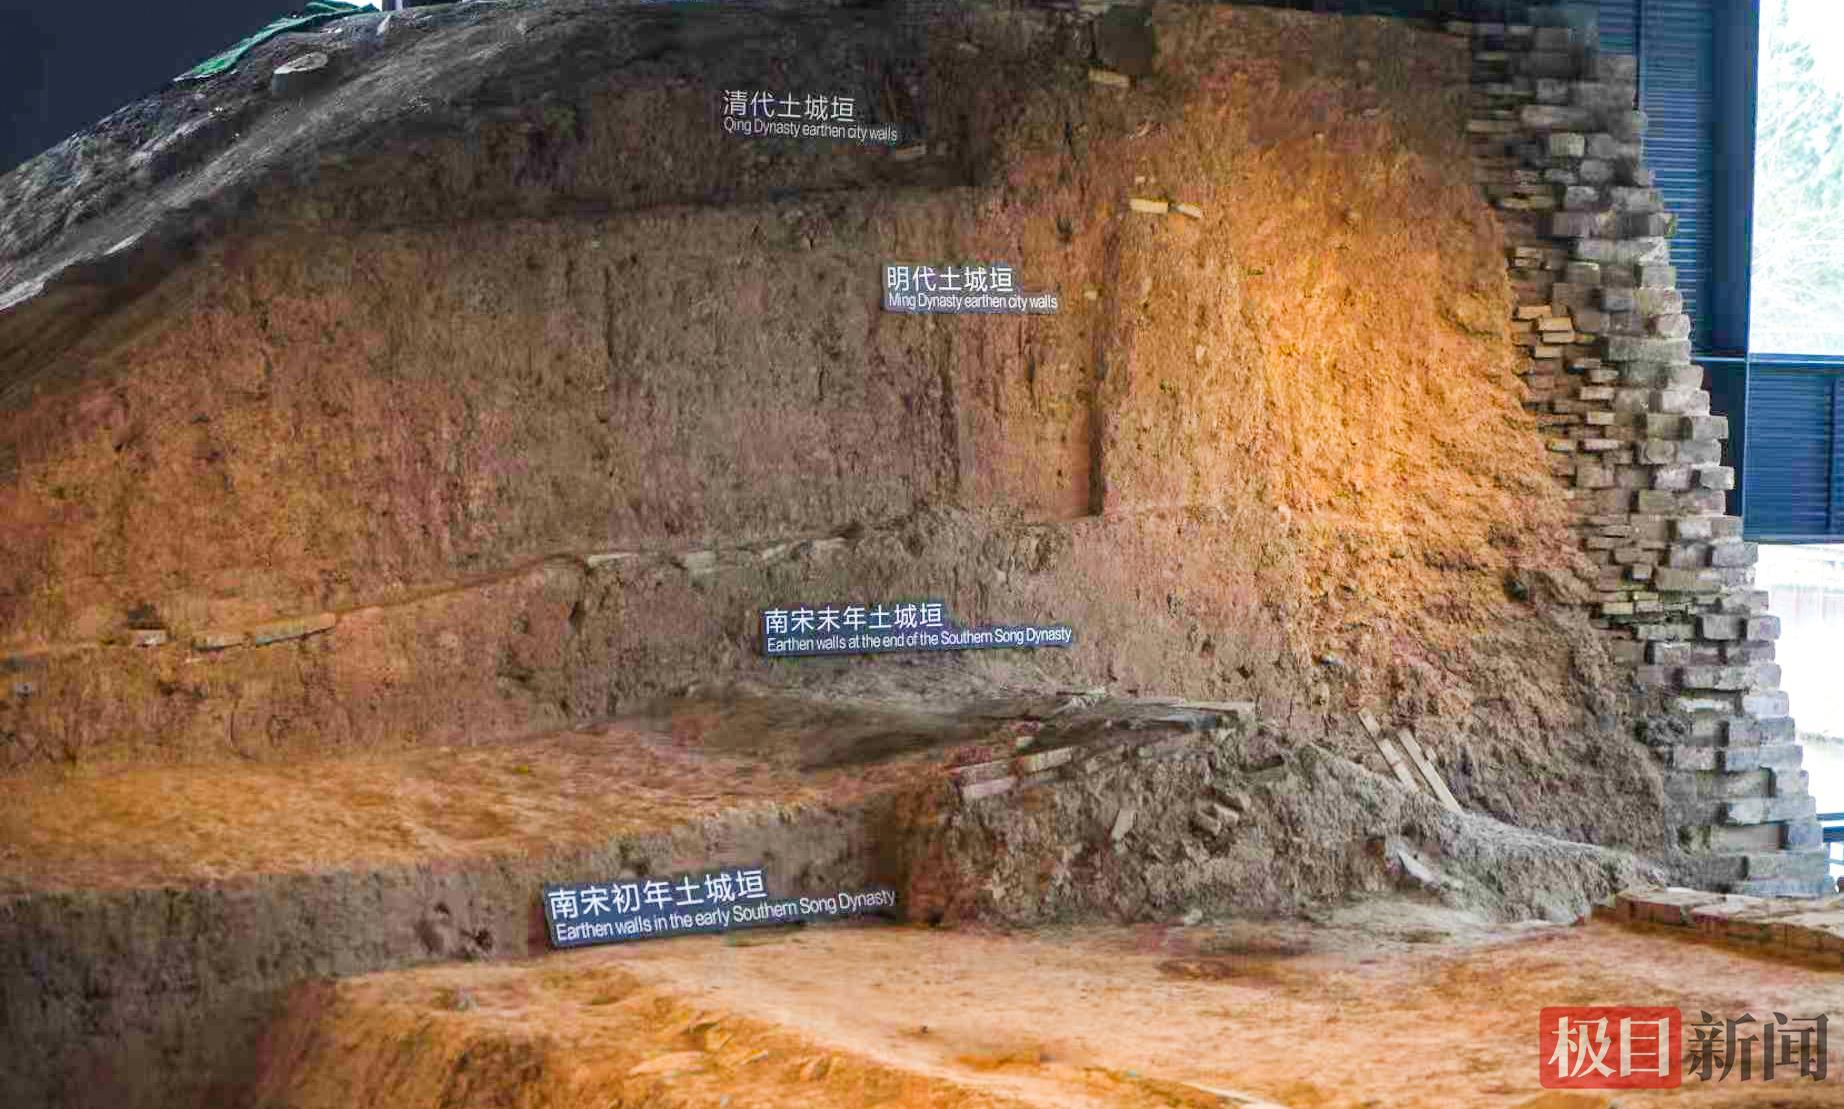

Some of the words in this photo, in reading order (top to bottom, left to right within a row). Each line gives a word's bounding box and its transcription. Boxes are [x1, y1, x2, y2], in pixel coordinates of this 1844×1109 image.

[723, 90, 855, 122] 清代土城垣
[724, 117, 752, 134] Qing
[754, 119, 799, 137] Dynasty
[802, 124, 845, 138] earthen
[848, 126, 868, 142] city
[870, 127, 897, 140] walls
[887, 266, 1013, 291] 明代土城垣
[889, 293, 916, 309] Ming
[919, 293, 961, 310] Dynasty
[964, 295, 1006, 308] earthen
[1008, 295, 1027, 310] city
[1029, 295, 1057, 309] walls
[765, 603, 943, 634] 南宋末年土城垣
[768, 637, 813, 652] Earthen
[816, 635, 845, 650] walls
[849, 636, 859, 649] at
[862, 635, 880, 648] the
[883, 634, 904, 647] end
[907, 632, 918, 647] of
[920, 632, 938, 646] the
[941, 630, 992, 645] Southern
[995, 628, 1024, 644] Song
[1026, 627, 1072, 643] Dynasty
[548, 870, 766, 919] 南宋初年土城垣
[556, 920, 614, 941] Earthen
[616, 915, 652, 935] walls
[654, 914, 668, 931] in
[670, 911, 693, 929] the
[695, 907, 730, 927] early
[733, 902, 797, 923] Southern
[800, 897, 837, 915] Song
[839, 890, 895, 910] Dynasty
